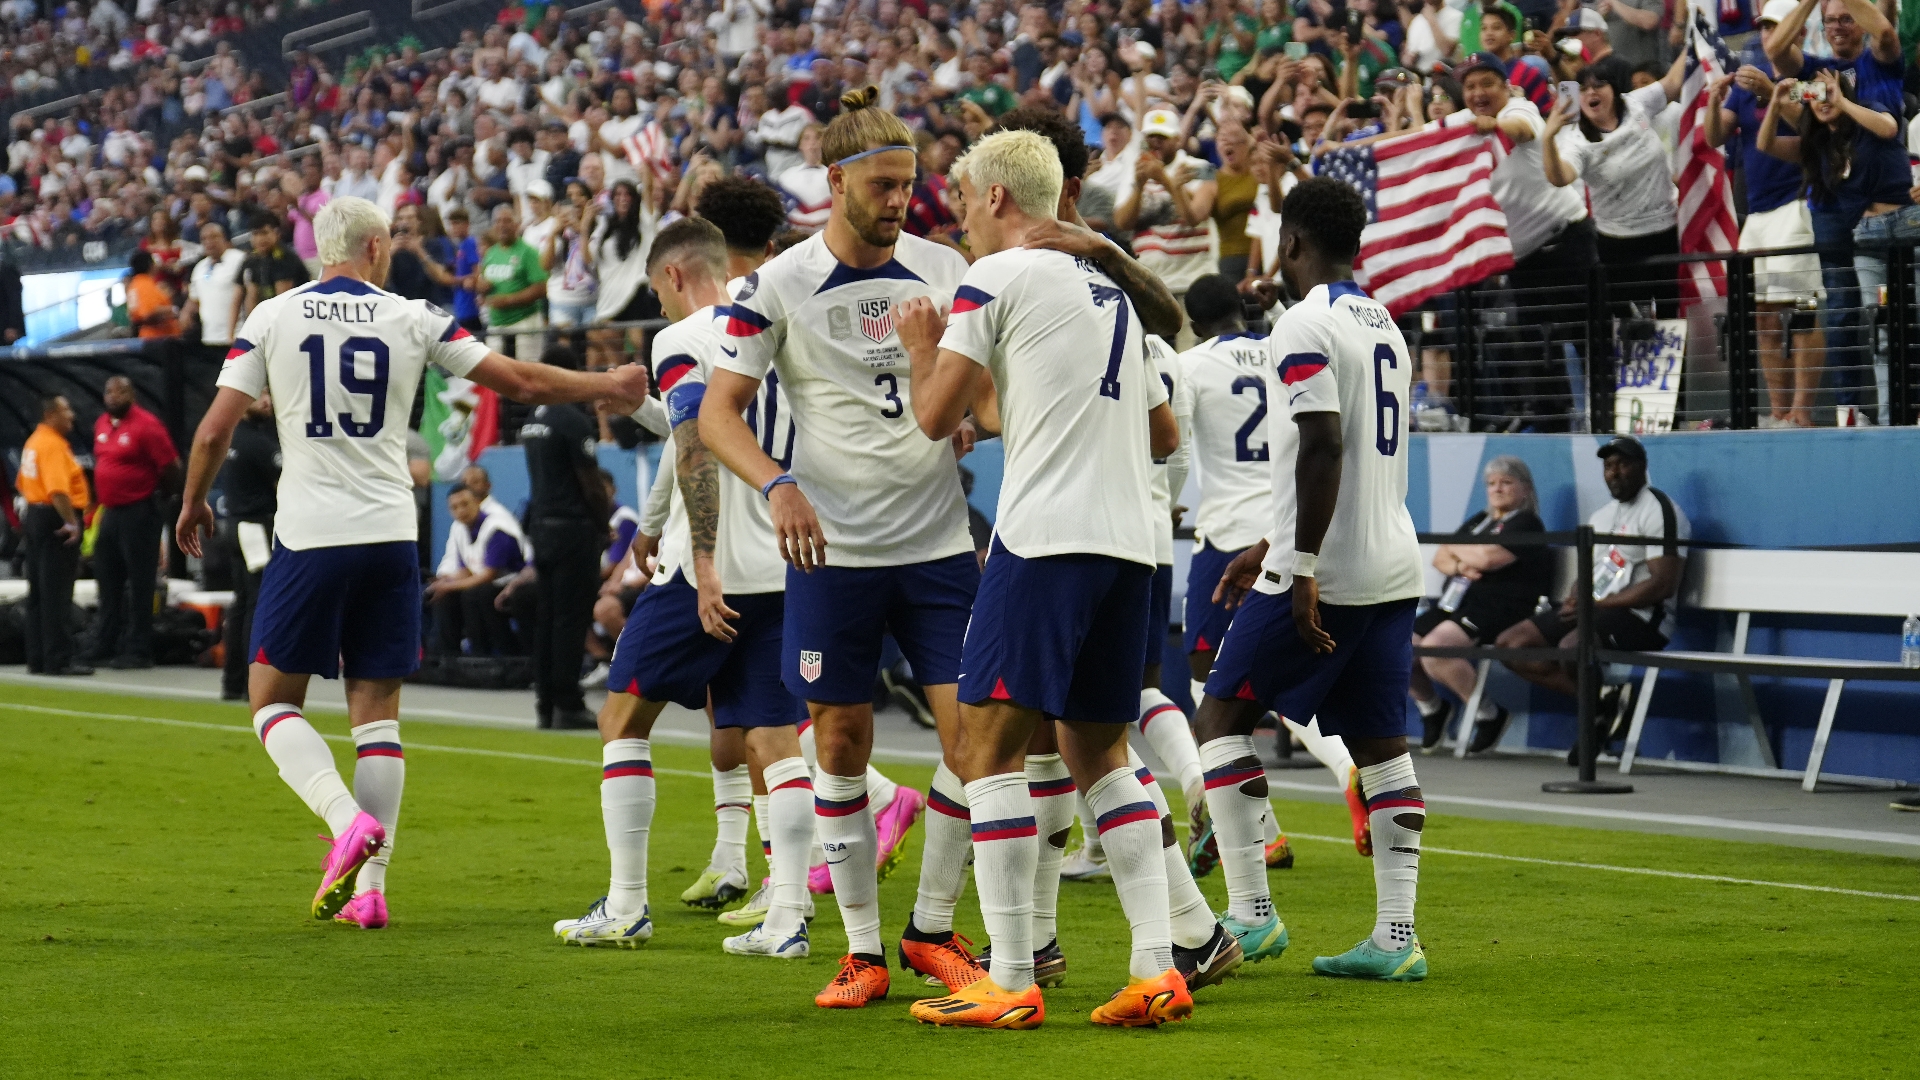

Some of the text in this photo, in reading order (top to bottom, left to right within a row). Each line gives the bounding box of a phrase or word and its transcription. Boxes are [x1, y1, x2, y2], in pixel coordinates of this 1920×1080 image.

[303, 299, 378, 323] SCALLY
[861, 300, 888, 318] USA
[1348, 304, 1395, 331] MUSAH
[1087, 282, 1128, 400] 7
[299, 334, 390, 437] 19
[874, 373, 903, 418] 3
[1374, 343, 1399, 456] 6
[1231, 375, 1270, 462] 2
[801, 651, 821, 665] USA
[823, 842, 847, 852] USA
